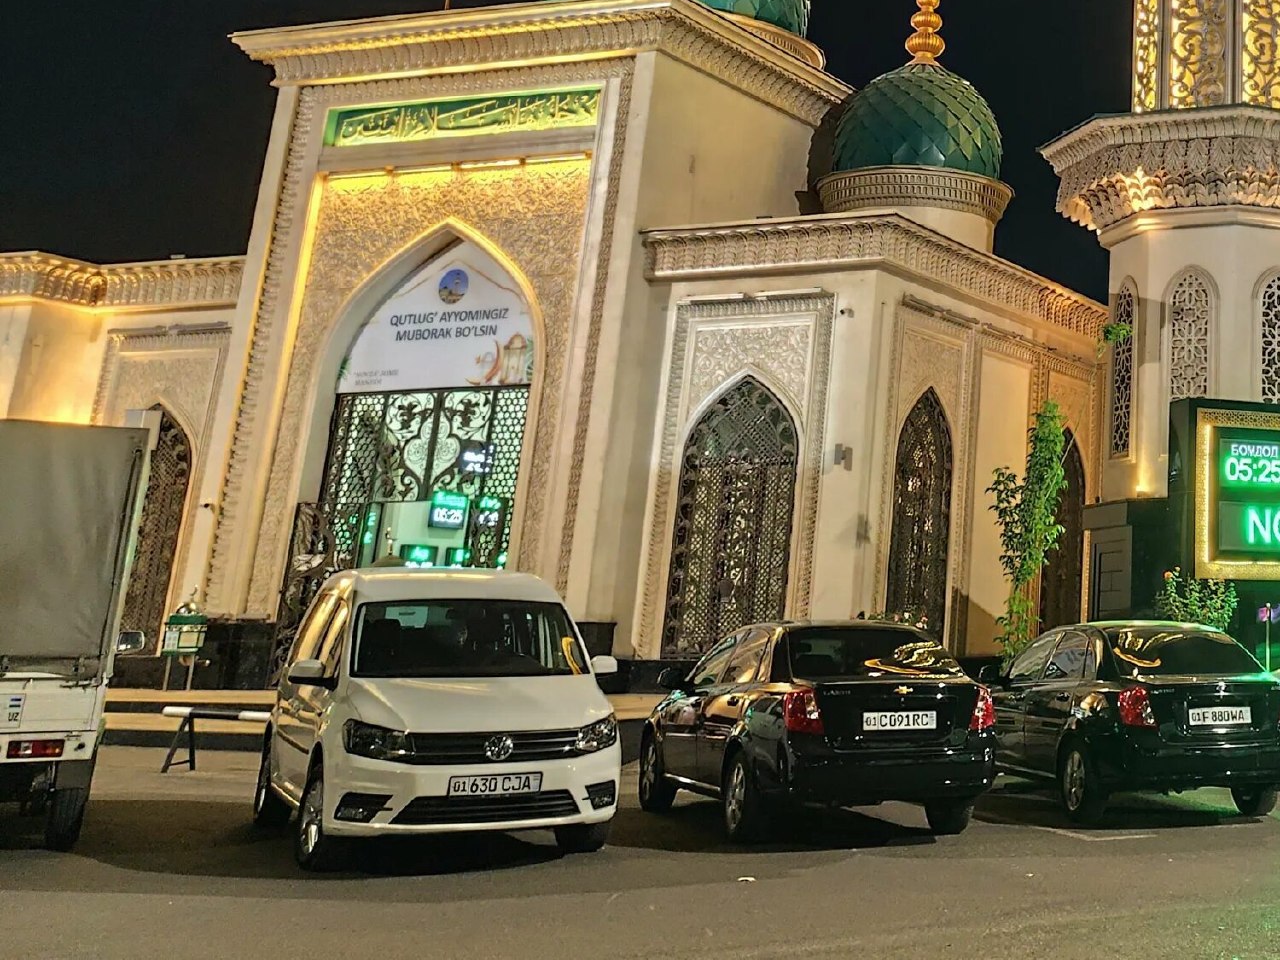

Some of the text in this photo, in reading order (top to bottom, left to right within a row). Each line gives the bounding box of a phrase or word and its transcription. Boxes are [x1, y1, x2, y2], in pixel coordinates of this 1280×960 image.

[439, 308, 509, 323] AYYOMINGIZ
[395, 327, 452, 341] MUBORAK
[1231, 444, 1279, 458] БОМДОД
